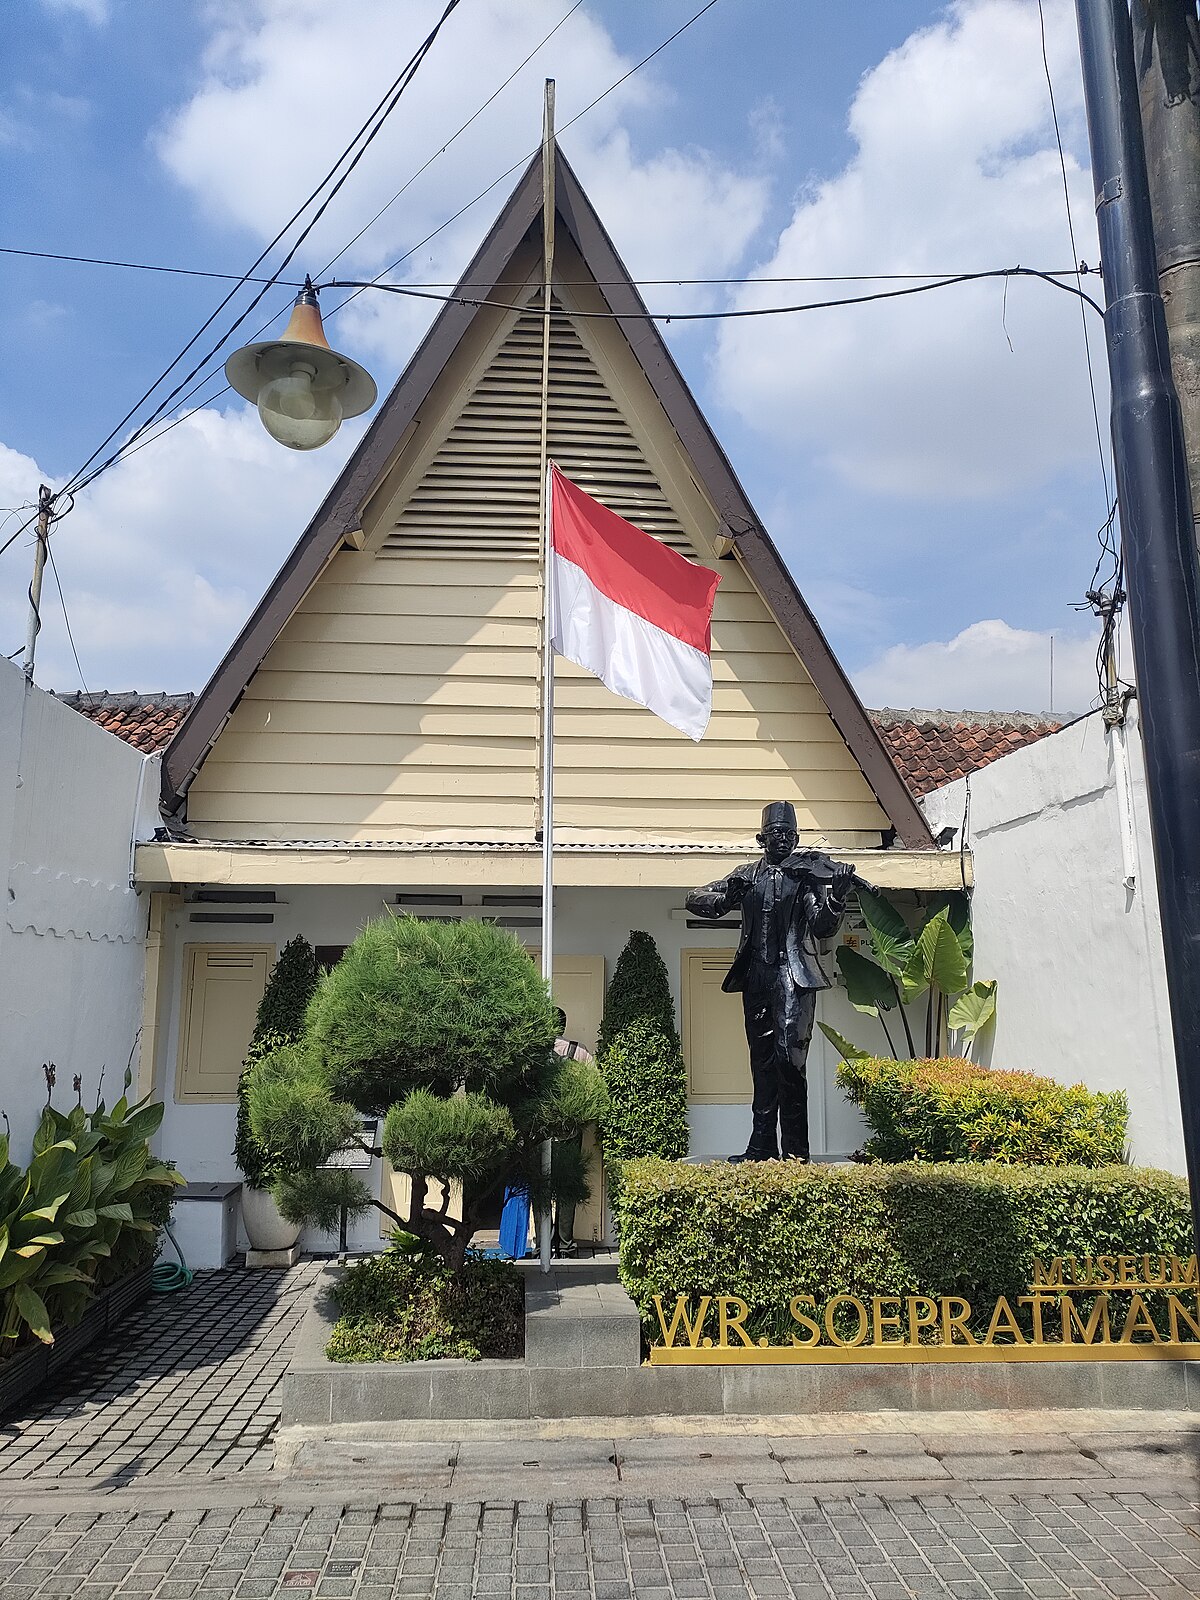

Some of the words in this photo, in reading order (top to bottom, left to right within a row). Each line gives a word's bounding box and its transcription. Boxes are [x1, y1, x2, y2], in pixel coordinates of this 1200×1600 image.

[1033, 1254, 1199, 1286] MUSEUM
[652, 1294, 769, 1348] W.R.
[789, 1294, 1200, 1347] SOEPRATMAN
